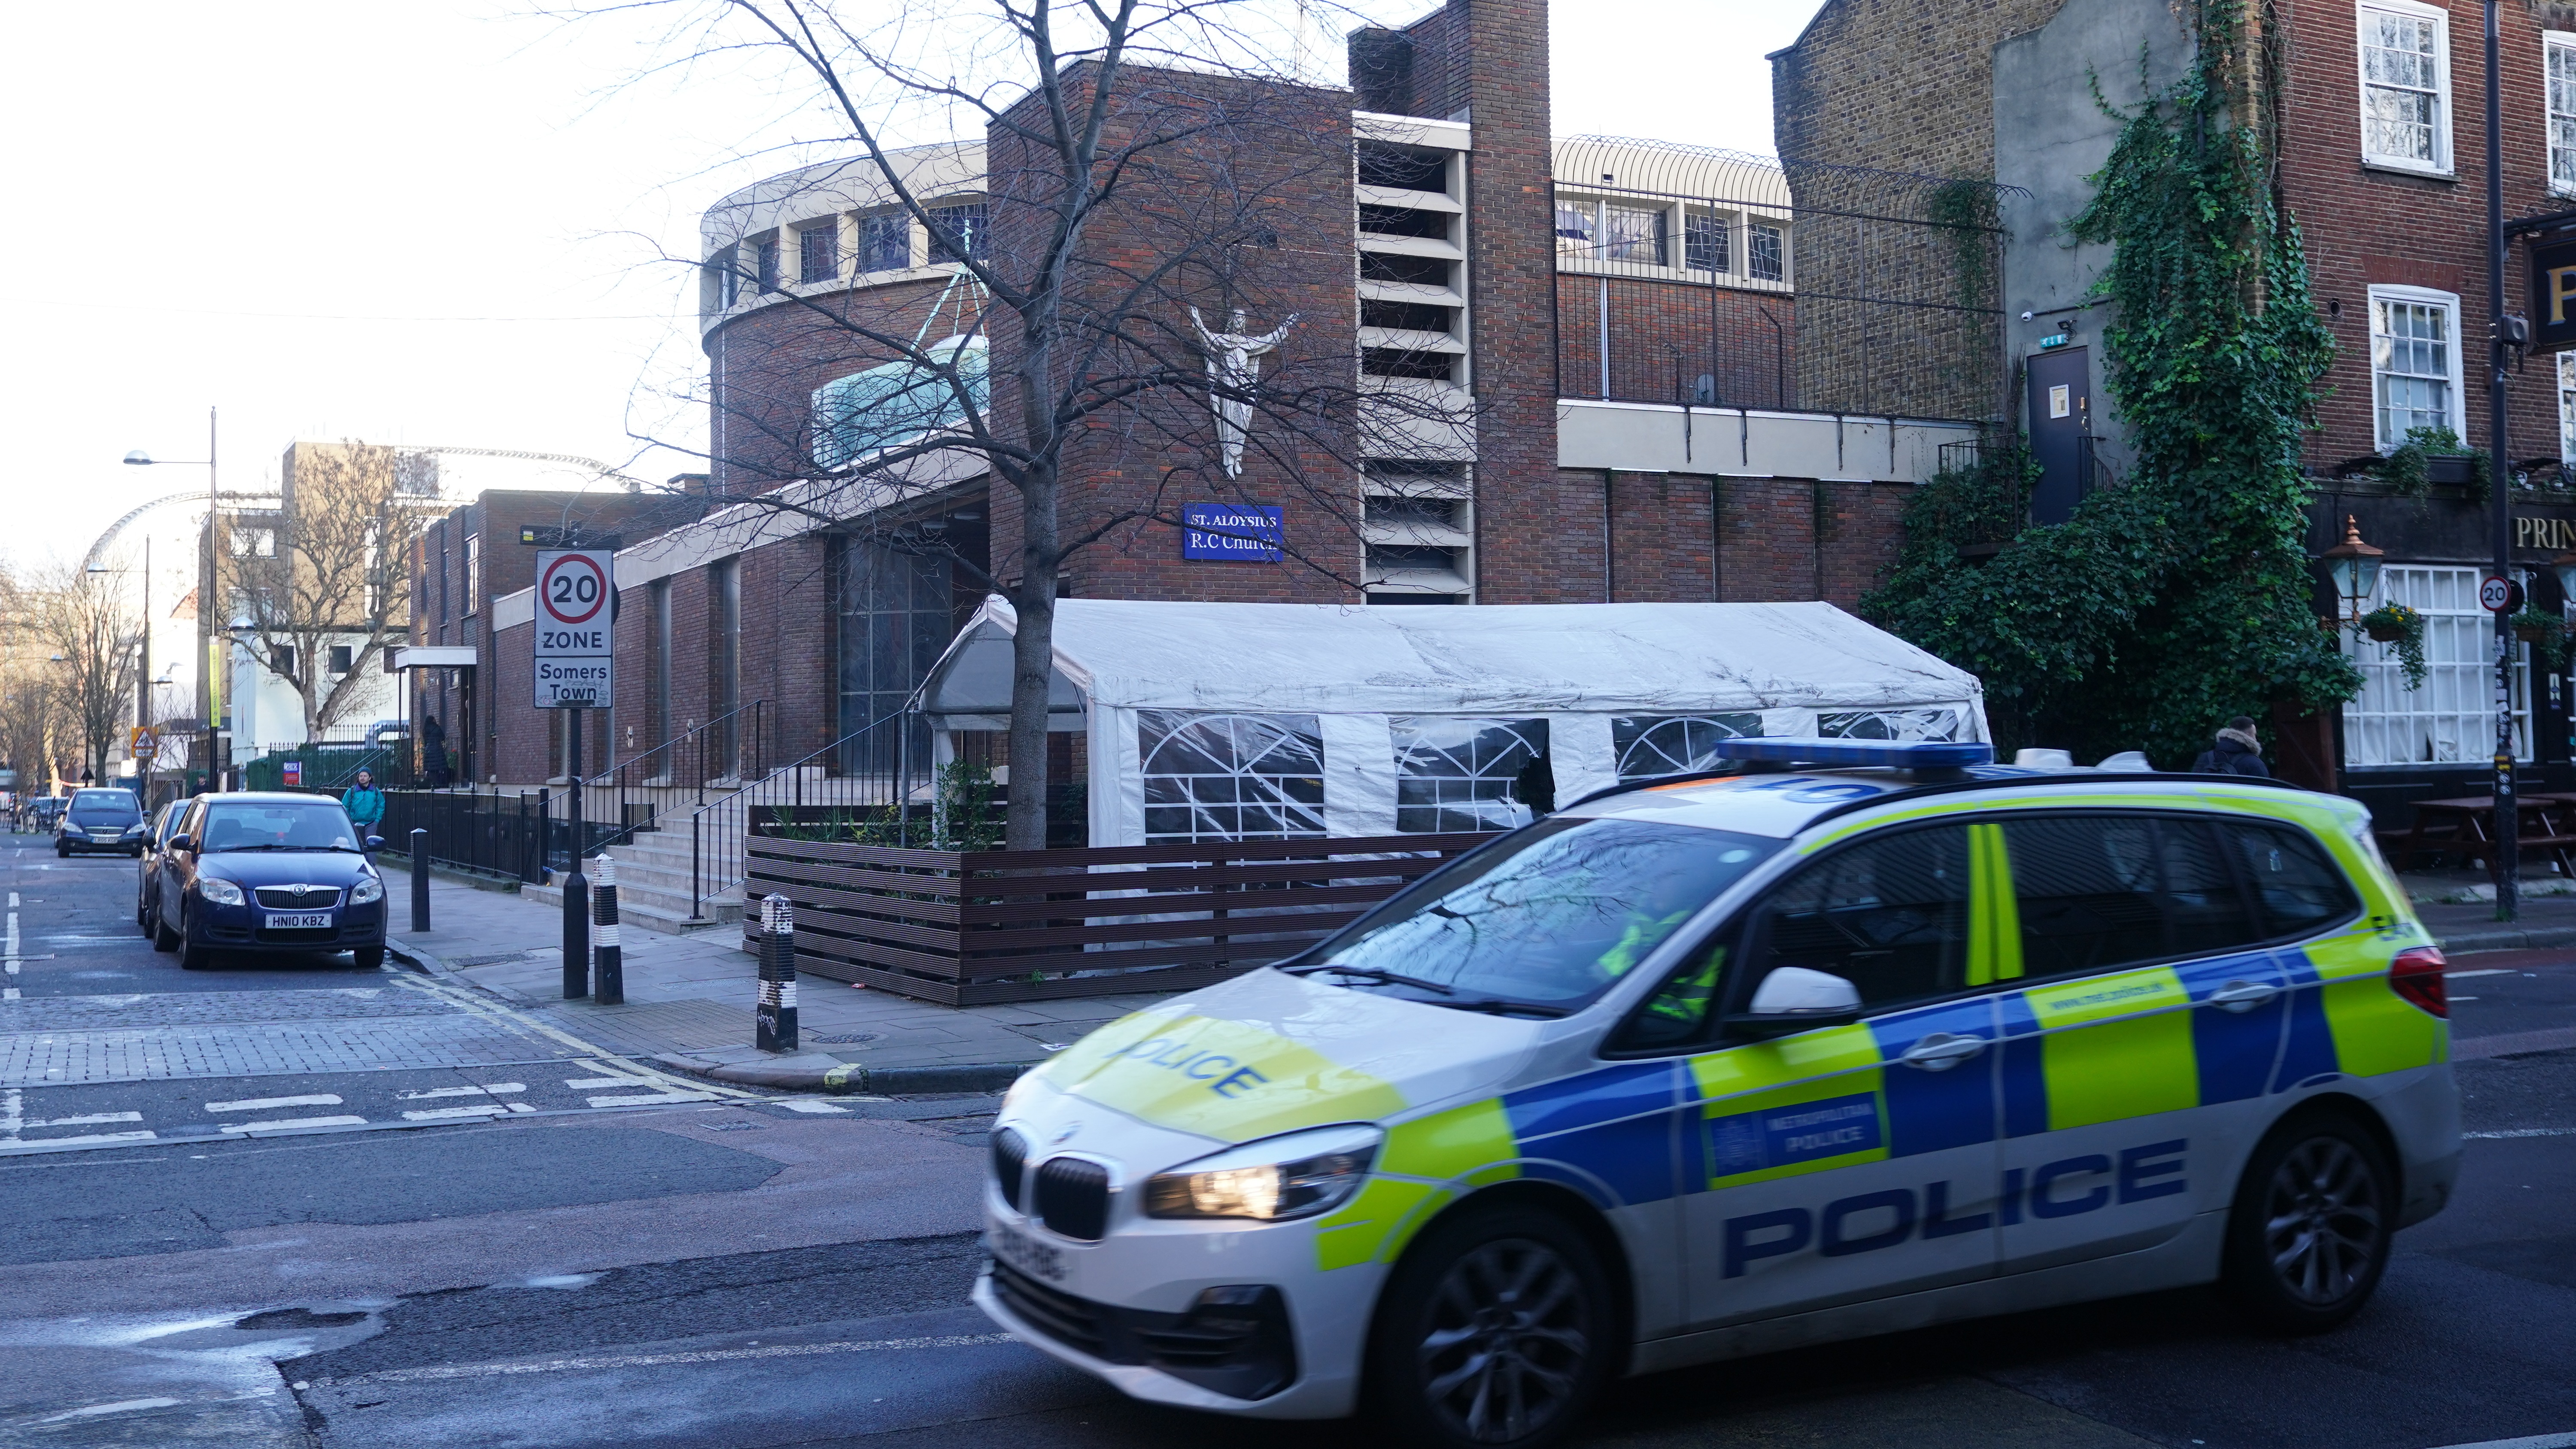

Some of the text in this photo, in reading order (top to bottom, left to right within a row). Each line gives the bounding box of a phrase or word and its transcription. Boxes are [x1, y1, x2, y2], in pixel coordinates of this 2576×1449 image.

[1191, 515, 1276, 527] ST. ALOYSIUS
[1191, 533, 1218, 549] R.C
[553, 575, 597, 603] 20
[2484, 586, 2506, 601] 20
[543, 632, 602, 648] ZONE
[540, 663, 607, 679] Somers
[550, 684, 596, 699] Town
[273, 916, 325, 927] HN10 KBZ
[1785, 1126, 1865, 1153] POLICE
[1719, 1138, 2187, 1280] POLICE
